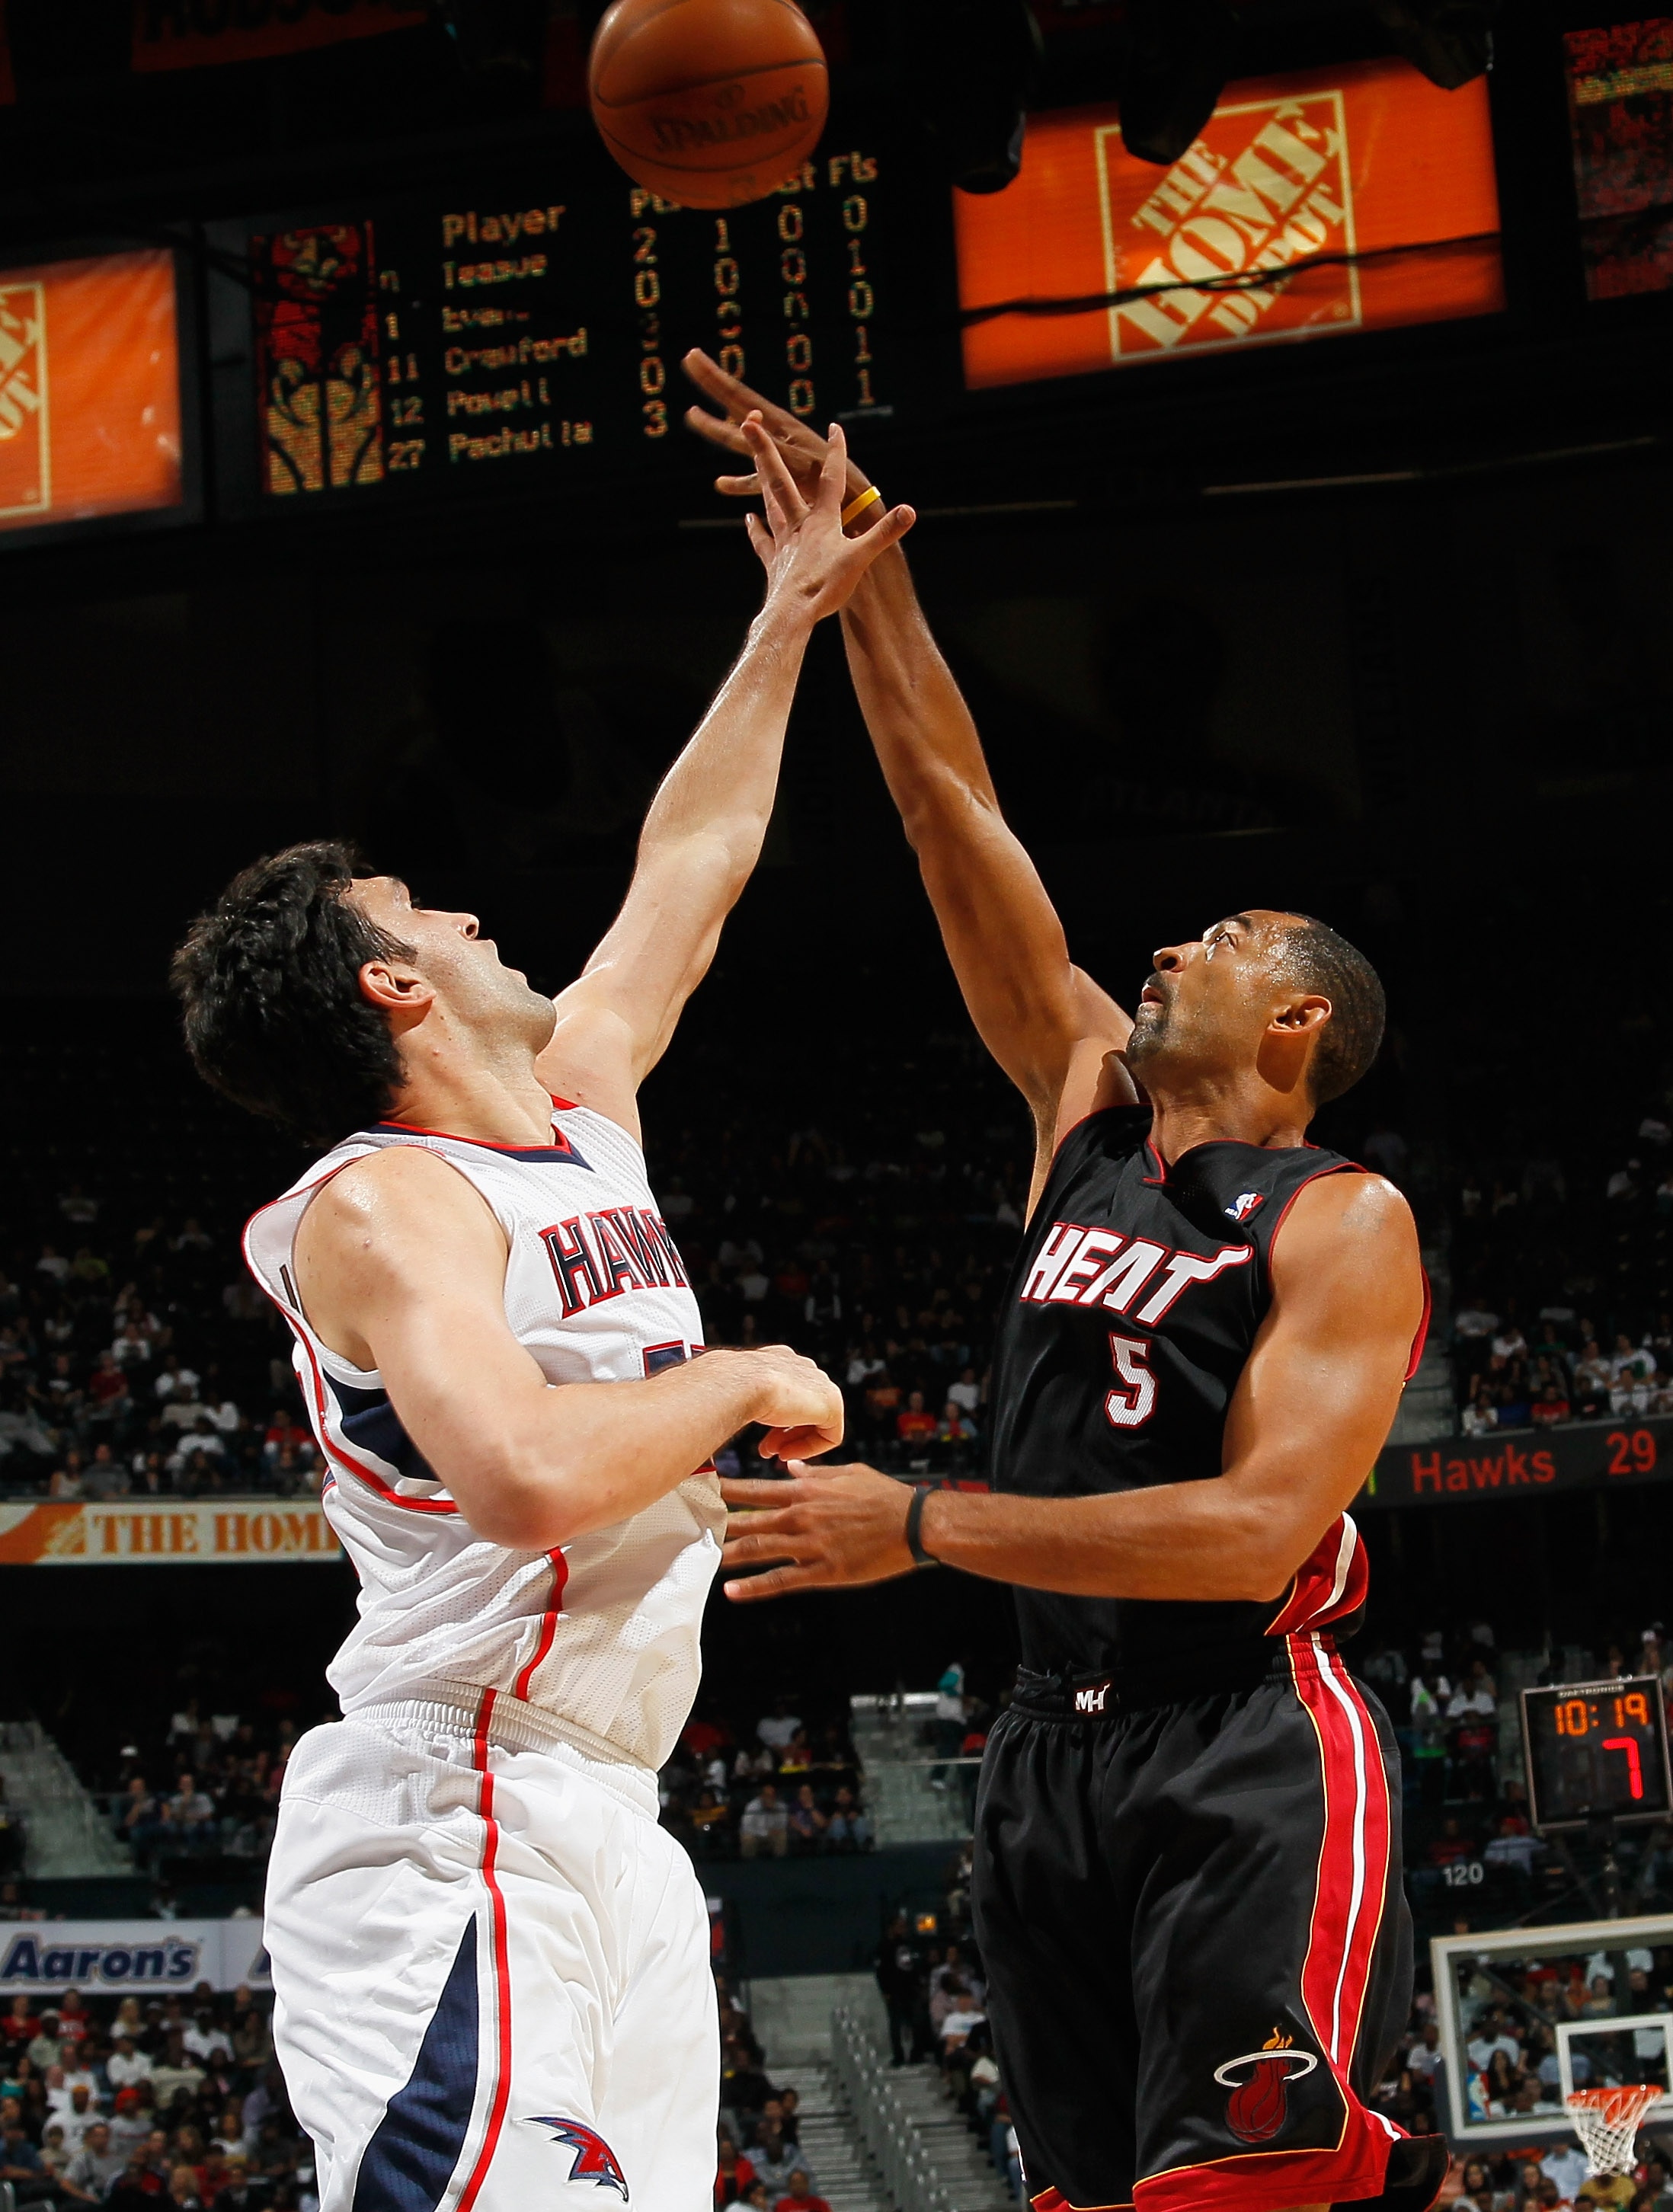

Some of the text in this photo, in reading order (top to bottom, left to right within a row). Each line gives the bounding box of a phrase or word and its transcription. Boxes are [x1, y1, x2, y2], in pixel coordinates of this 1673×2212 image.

[1131, 139, 1228, 238] THE
[441, 204, 568, 248] Player
[632, 226, 658, 264] 2
[714, 216, 731, 253] 1
[777, 203, 804, 243] 0
[841, 194, 868, 232] 0
[1115, 101, 1339, 349] HOME
[634, 268, 661, 308] 0
[714, 257, 741, 296] 0
[780, 246, 807, 286] 0
[847, 238, 868, 276] 1
[388, 353, 419, 384] 11
[848, 280, 875, 320] 0
[391, 395, 424, 427] 12
[639, 355, 667, 395] 0
[719, 344, 746, 382] 0
[785, 333, 813, 372] 0
[854, 324, 874, 364] 1
[388, 438, 425, 471] 27
[641, 399, 669, 439] 3
[789, 378, 816, 417] 0
[856, 368, 876, 407] 1
[1019, 1222, 1255, 1327] HEAT
[1105, 1331, 1158, 1430] 5
[1412, 1443, 1556, 1493] Hawks
[1606, 1428, 1657, 1475] 29
[94, 1514, 198, 1553] THE
[1554, 1693, 1649, 1737] 10:19
[1601, 1737, 1644, 1799] 7
[1443, 1862, 1483, 1886] 120
[2, 1939, 194, 1978] Aaron's
